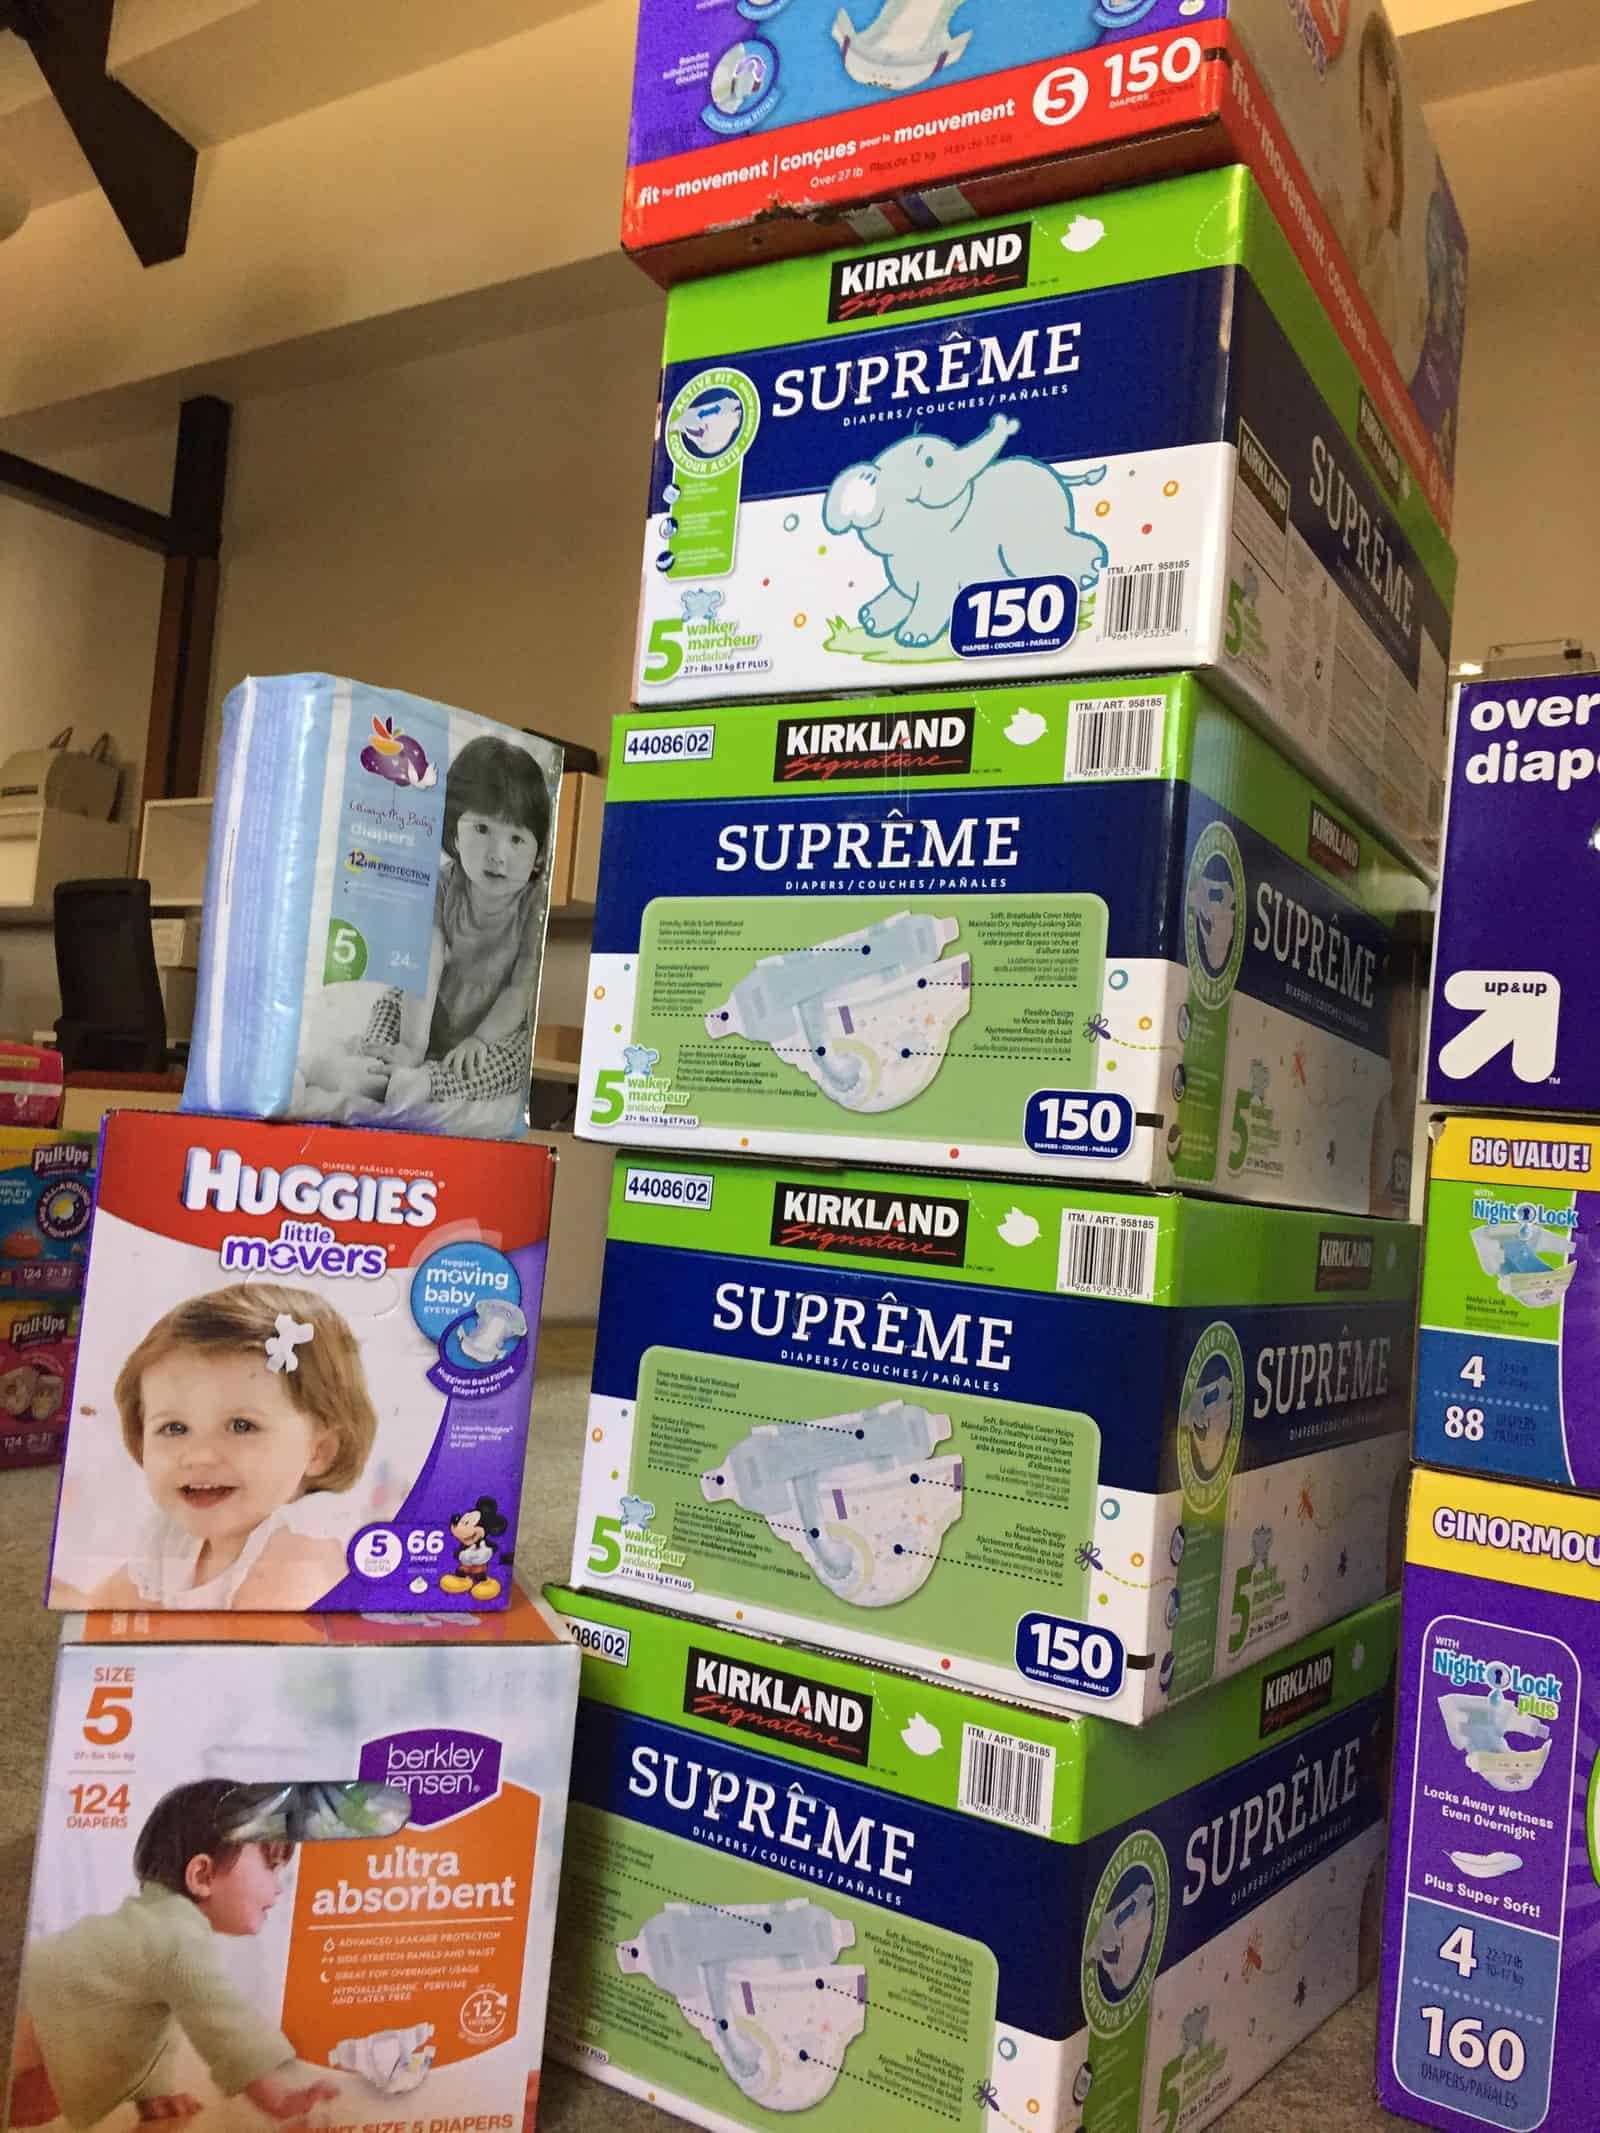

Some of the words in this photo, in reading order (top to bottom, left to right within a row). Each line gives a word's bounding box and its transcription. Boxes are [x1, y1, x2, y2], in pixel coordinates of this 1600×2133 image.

[1044, 72, 1079, 121] 5
[1103, 37, 1201, 98] 150
[639, 182, 660, 208] fit
[675, 159, 769, 198] movement
[780, 139, 857, 171] conçues
[894, 98, 1016, 145] mouvement
[810, 174, 836, 189] Over
[837, 170, 851, 185] 27
[852, 167, 864, 181] lb
[840, 232, 1023, 297] KIRKLAND
[838, 273, 1020, 320] Signature
[772, 322, 1082, 418] SUPRÊME
[1309, 435, 1415, 637] SUPRÊME
[1158, 559, 1190, 571] 958185
[686, 618, 736, 636] walker
[968, 584, 1065, 639] 150
[643, 619, 683, 683] 5
[687, 632, 759, 651] marcheur
[748, 660, 769, 671] PLUS
[1075, 702, 1096, 712] ITM.
[1128, 697, 1163, 709] 958185
[786, 717, 966, 756] KIRKLAND
[783, 751, 963, 782] Signature
[1465, 740, 1600, 791] diap
[715, 808, 1020, 873] SUPRÊME
[334, 928, 357, 964] 5
[1253, 881, 1375, 1009] SUPRÊME
[1484, 980, 1548, 997] up&up
[591, 1069, 624, 1124] 5
[628, 1076, 671, 1090] walker
[628, 1090, 689, 1104] marcheur
[679, 1117, 697, 1126] PLUS
[1039, 1098, 1121, 1142] 150
[1470, 1136, 1509, 1166] BIG
[1512, 1139, 1593, 1173] VALUE!
[183, 1147, 439, 1228] HUGGIES
[783, 1190, 960, 1238] KIRKLAND
[1068, 1212, 1086, 1223] ITM.
[1095, 1215, 1118, 1227] ART.
[1120, 1218, 1155, 1230] 958185
[1472, 1199, 1518, 1225] Night
[1538, 1204, 1579, 1228] Lock
[284, 1223, 332, 1244] little
[780, 1221, 957, 1257] Signature
[225, 1237, 383, 1276] movers
[424, 1283, 476, 1308] baby
[426, 1266, 509, 1291] moving
[713, 1283, 1014, 1371] SUPRÊME
[1252, 1327, 1391, 1420] SUPRÊME
[1460, 1355, 1486, 1388] 4
[1444, 1405, 1485, 1442] 88
[370, 1534, 388, 1557] 5
[407, 1529, 445, 1554] 66
[587, 1515, 621, 1574] 5
[624, 1528, 667, 1546] walker
[625, 1544, 687, 1566] marcheur
[567, 1623, 602, 1650] 086
[1030, 1622, 1113, 1680] 150
[1435, 1635, 1460, 1650] WITH
[94, 1667, 136, 1683] SIZE
[1264, 1656, 1332, 1711] KIRKLAND
[1434, 1649, 1486, 1687] Night
[1511, 1668, 1561, 1702] Lock
[695, 1657, 864, 1734] KIRKLAND
[1517, 1694, 1559, 1721] plus
[83, 1687, 134, 1746] 5
[693, 1694, 861, 1753] Signature
[388, 1741, 484, 1773] berkley
[967, 1726, 986, 1739] ITM.
[1018, 1741, 1051, 1758] 958185
[69, 1783, 131, 1815] 124
[628, 1746, 915, 1886] SUPRÊME
[1423, 1784, 1460, 1806] Locks
[1461, 1794, 1496, 1815] Away
[1498, 1802, 1554, 1830] Wetness
[67, 1815, 128, 1830] DIAPERS
[1182, 1737, 1361, 1907] SUPRÊME
[1441, 1804, 1472, 1823] Even
[1474, 1813, 1537, 1842] Overnight
[368, 1845, 461, 1880] ultra
[312, 1876, 517, 1916] absorbent
[1424, 1872, 1454, 1894] Plus
[1456, 1882, 1499, 1907] Super
[1502, 1896, 1541, 1919] Soft!
[1439, 1926, 1478, 1979] 4
[472, 2000, 493, 2018] 12
[1420, 2005, 1526, 2082] 160
[429, 2114, 513, 2133] DIAPERS
